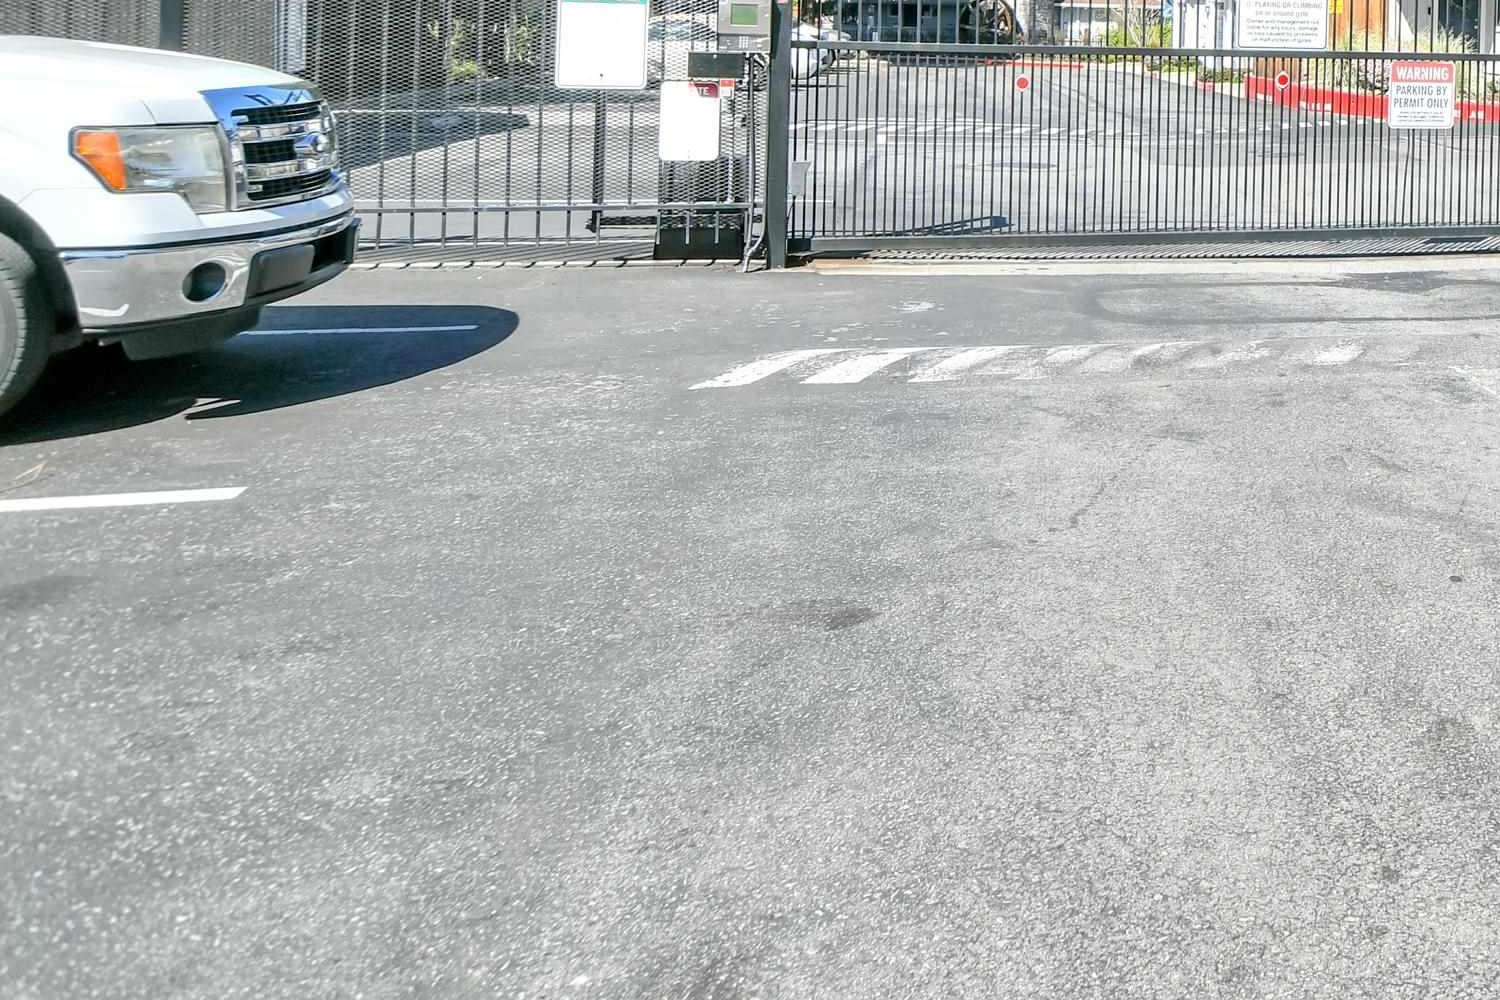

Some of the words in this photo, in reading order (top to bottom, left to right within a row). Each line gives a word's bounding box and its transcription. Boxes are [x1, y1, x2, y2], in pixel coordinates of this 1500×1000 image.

[1396, 66, 1450, 81] WARNING
[1396, 85, 1433, 96] PARKING
[1436, 86, 1448, 96] BY
[1393, 98, 1424, 108] PERMIT
[1427, 98, 1449, 108] ONLY
